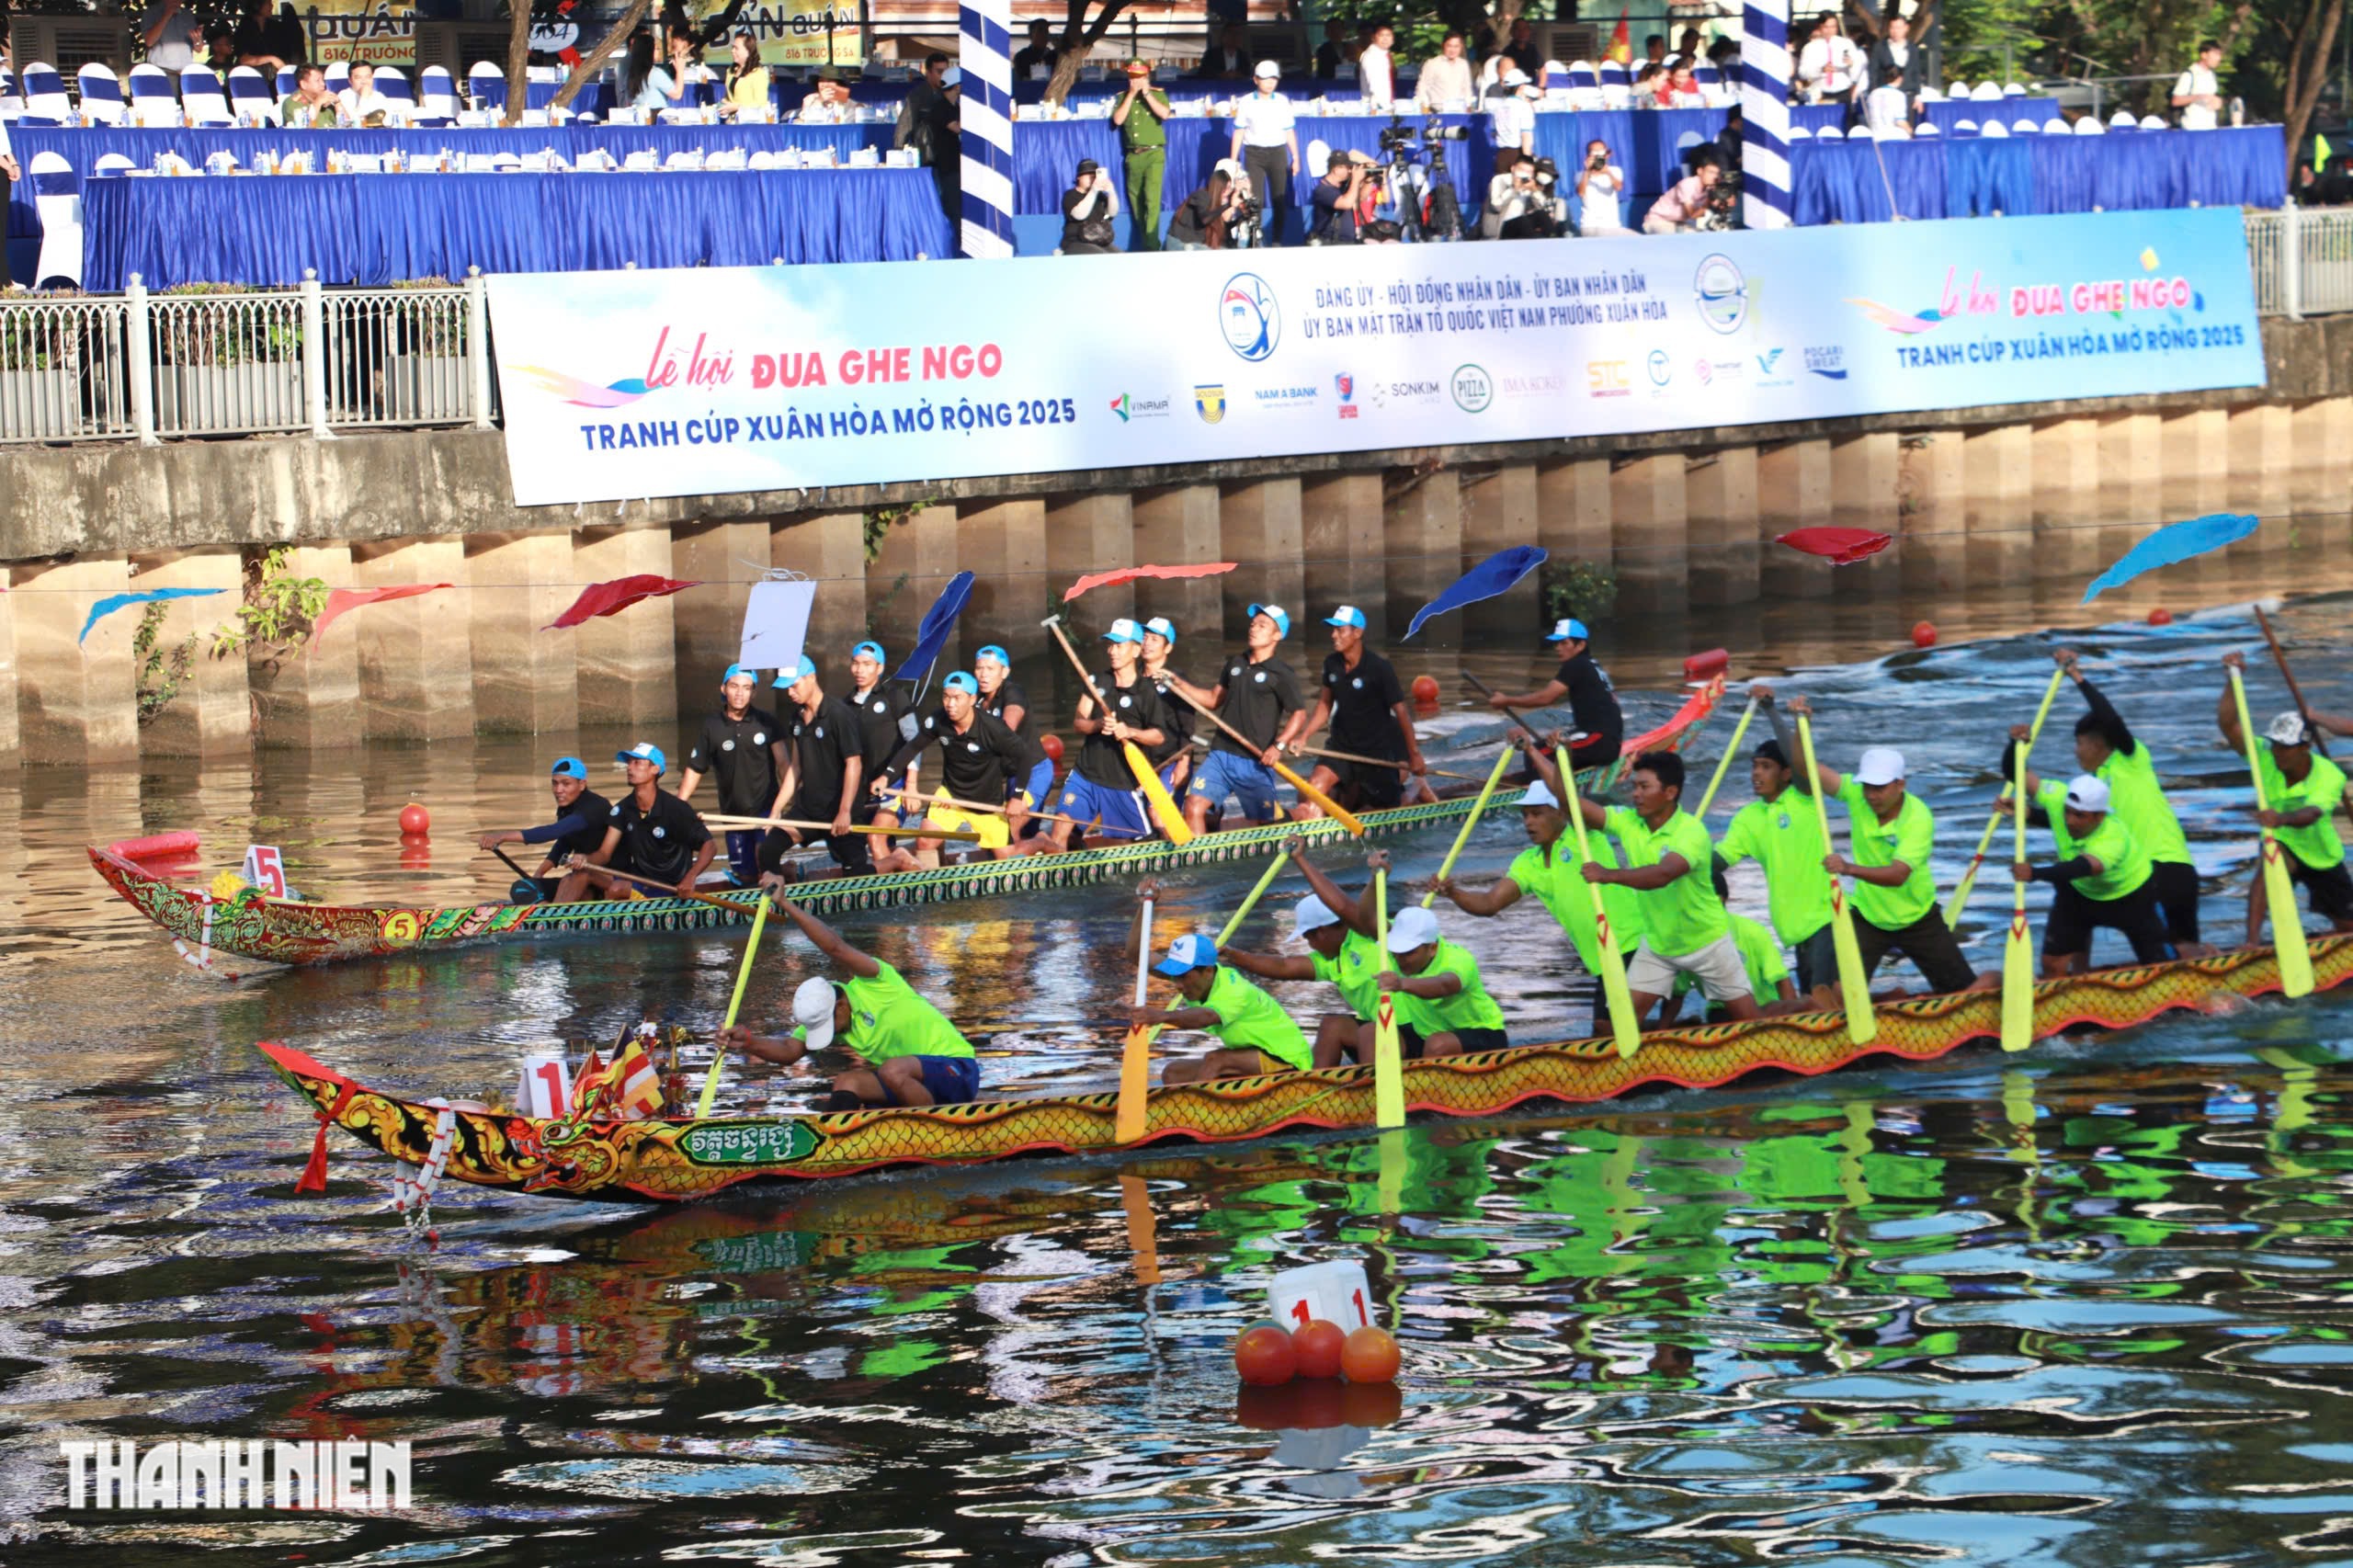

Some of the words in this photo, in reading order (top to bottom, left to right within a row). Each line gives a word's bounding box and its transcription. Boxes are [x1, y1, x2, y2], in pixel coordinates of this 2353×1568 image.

[324, 47, 349, 60] 816
[786, 48, 801, 59] 816
[1457, 275, 1493, 302] NHÂN
[1497, 274, 1522, 300] DÂN
[1554, 278, 1580, 299] BAN
[1584, 269, 1619, 296] NHÂN
[1622, 267, 1646, 294] DÂN
[2011, 285, 2064, 317] ĐUA
[2073, 280, 2124, 312] GHE
[2131, 277, 2191, 310] NGO
[1325, 316, 1354, 337] BAN
[1448, 303, 1484, 333] QUỐC
[1488, 303, 1515, 334] VIỆT
[1518, 307, 1546, 328] NAM
[1607, 297, 1639, 324] XUÂN
[1804, 345, 1844, 357] POCARI
[1805, 357, 1842, 368] SWEAT
[1897, 344, 1964, 369] TRANH
[1968, 335, 2006, 363] CÚP
[2011, 332, 2065, 361] XUÂN
[2069, 327, 2109, 357] HÒA
[2147, 324, 2199, 357] RỘNG
[2201, 324, 2245, 347] 2025
[750, 351, 827, 390] ĐUA
[837, 347, 912, 386] GHE
[921, 343, 1003, 381] NGO
[1256, 388, 1279, 401] NAM
[1290, 386, 1318, 399] BANK
[1392, 381, 1440, 397] SONKIM
[1458, 380, 1485, 398] PIZZA
[580, 420, 680, 451] TRANH
[686, 409, 741, 445] CÚP
[745, 406, 825, 442] XUÂN
[830, 402, 889, 437] HÒA
[892, 397, 935, 434] MỞ
[939, 396, 1013, 437] RỘNG
[1017, 398, 1076, 426] 2025
[256, 847, 283, 898] 5
[394, 918, 409, 940] 5
[536, 1061, 565, 1119] 1
[1352, 1288, 1369, 1327] 1
